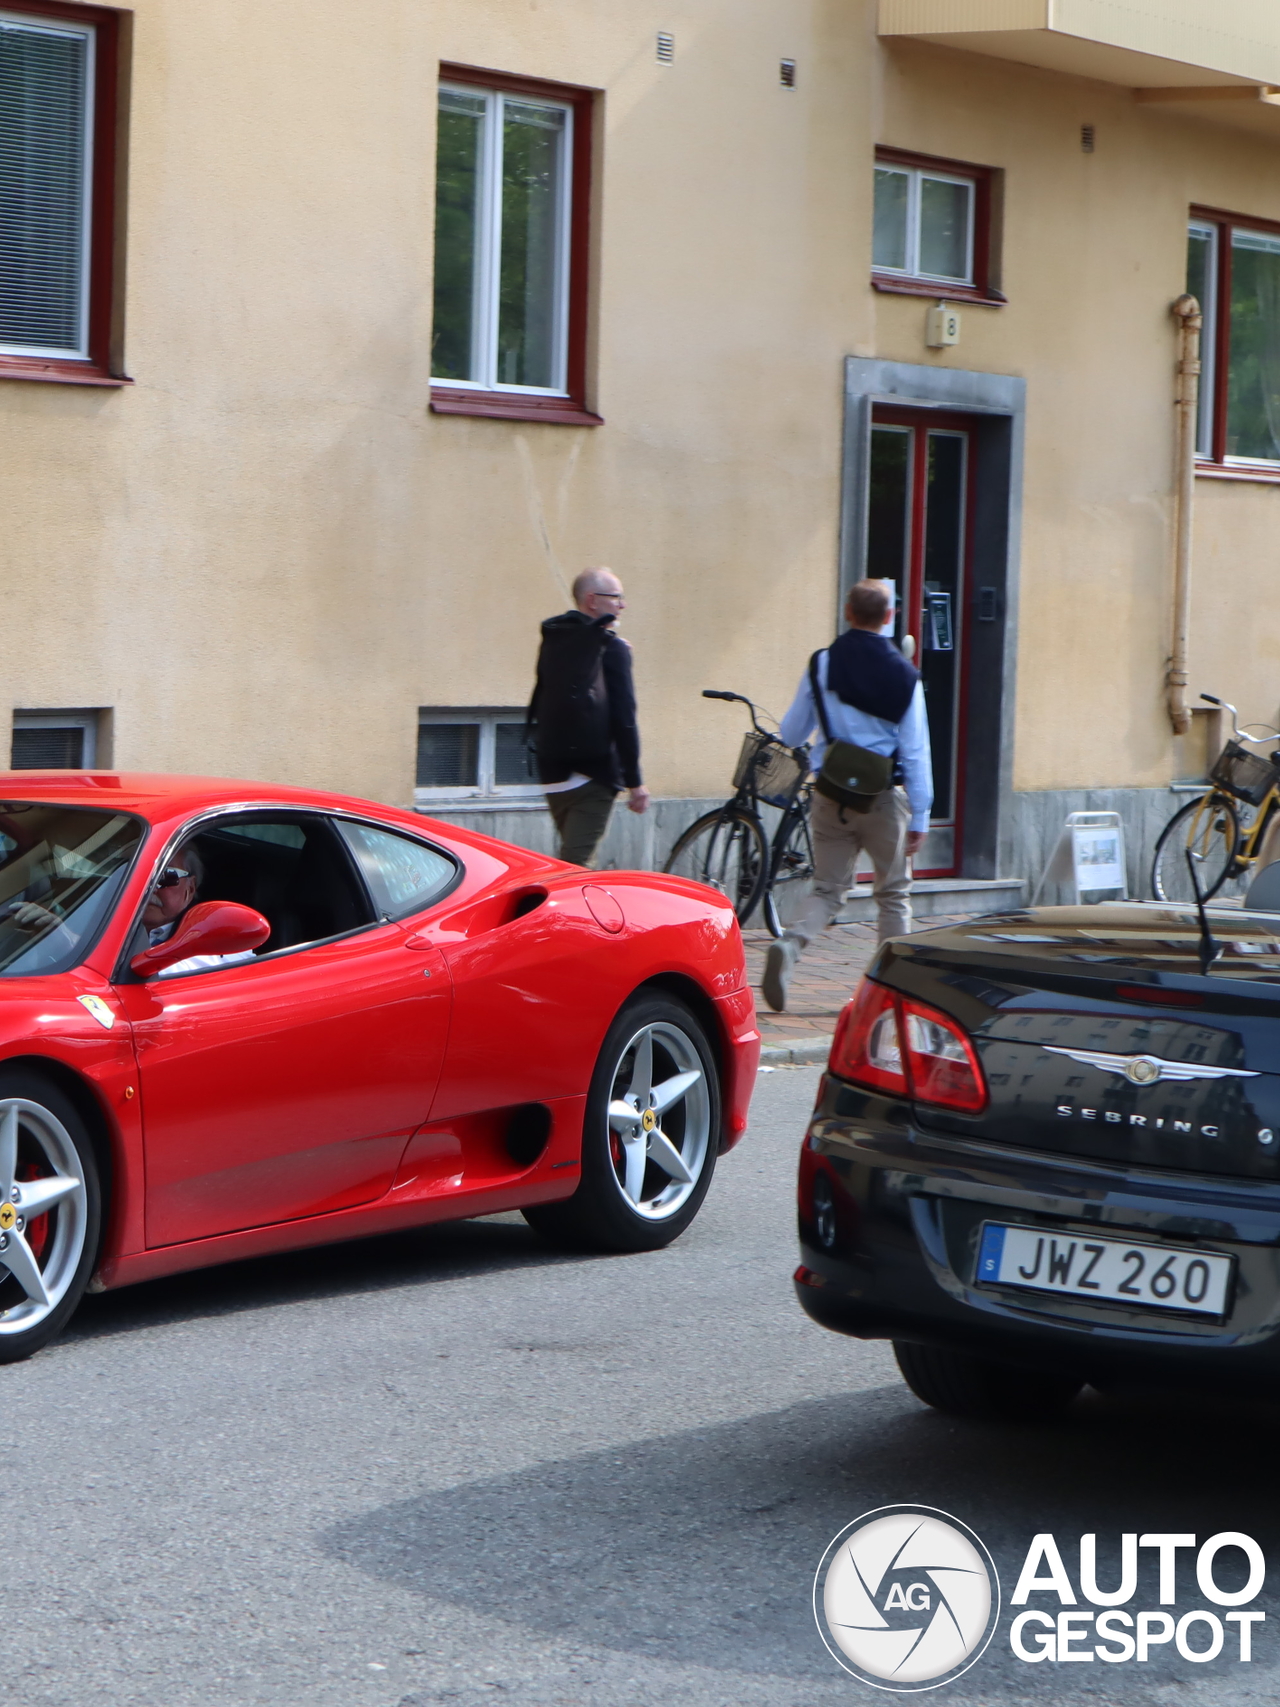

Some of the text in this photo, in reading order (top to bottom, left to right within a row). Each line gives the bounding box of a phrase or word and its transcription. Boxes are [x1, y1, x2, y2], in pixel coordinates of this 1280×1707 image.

[947, 318, 956, 336] 8
[1056, 1105, 1220, 1138] SEBRING
[984, 1258, 995, 1272] S
[1018, 1237, 1211, 1304] JWZ 260
